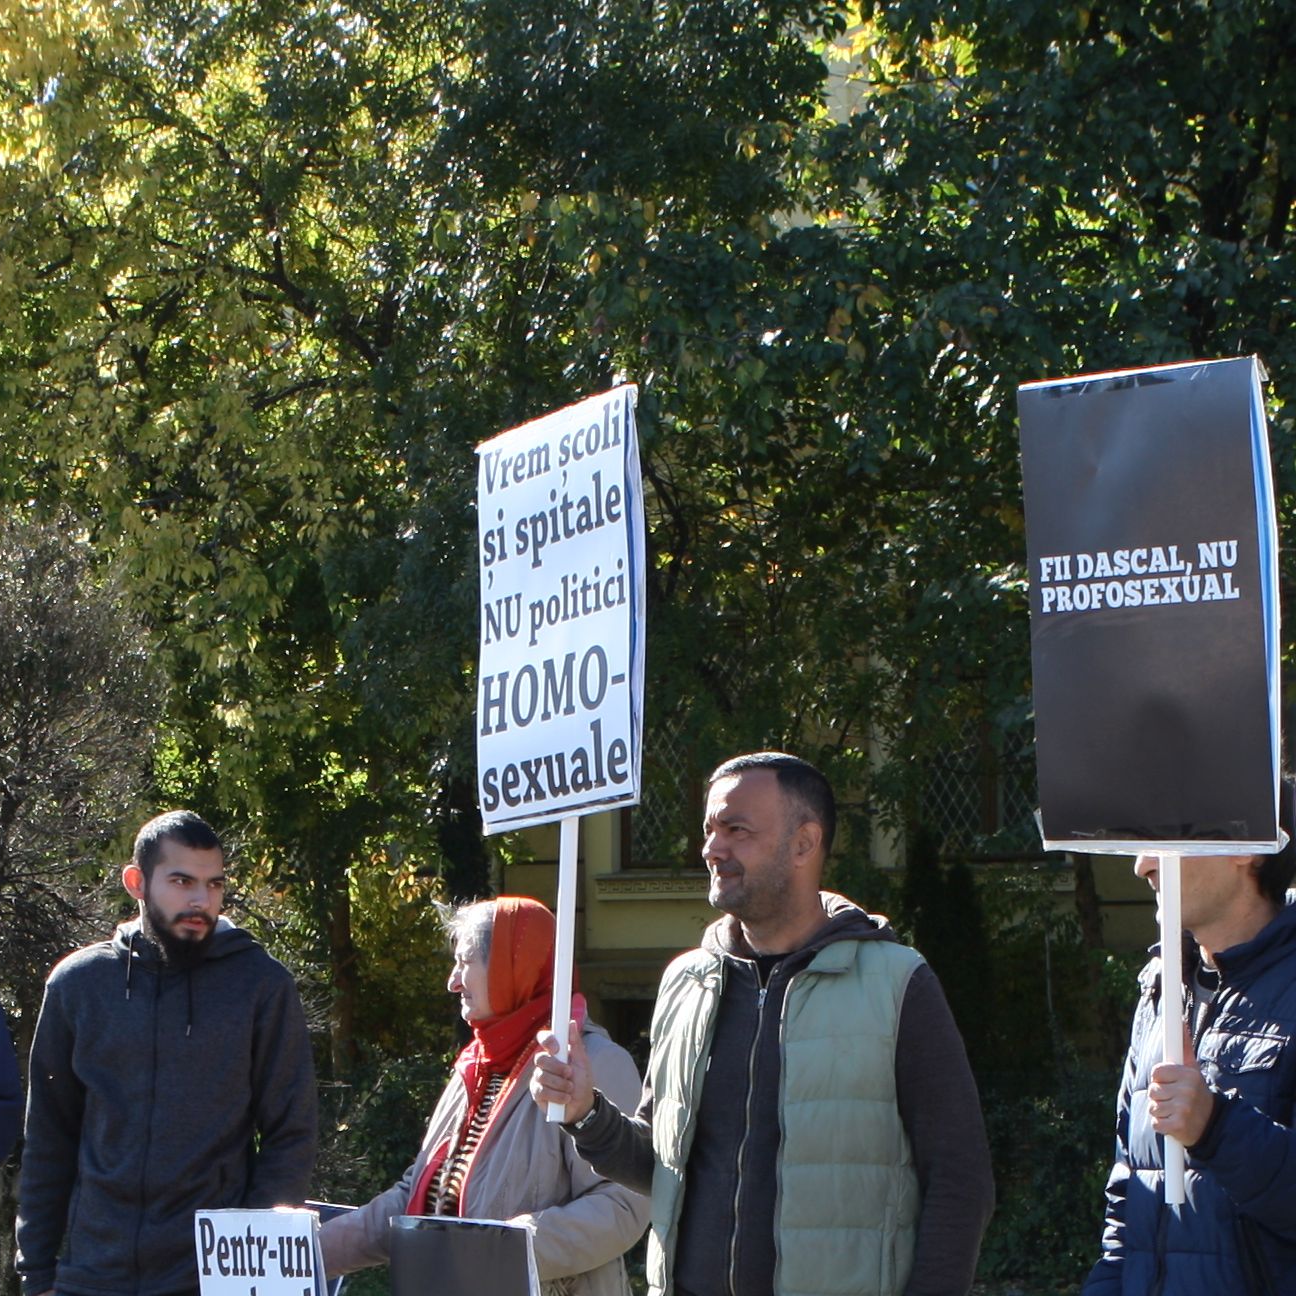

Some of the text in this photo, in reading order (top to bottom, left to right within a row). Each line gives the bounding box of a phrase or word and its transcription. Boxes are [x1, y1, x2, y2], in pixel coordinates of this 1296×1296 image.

[483, 399, 621, 495] Vrem școli
[483, 469, 624, 590] și spitale
[1039, 538, 1239, 583] FII DASCAL, NU
[483, 557, 627, 648] NU politici
[1040, 572, 1241, 614] PROFOSEXUAL
[479, 642, 628, 737] HOMO-
[482, 717, 630, 813] sexuale
[198, 1217, 314, 1278] Pentr-un
